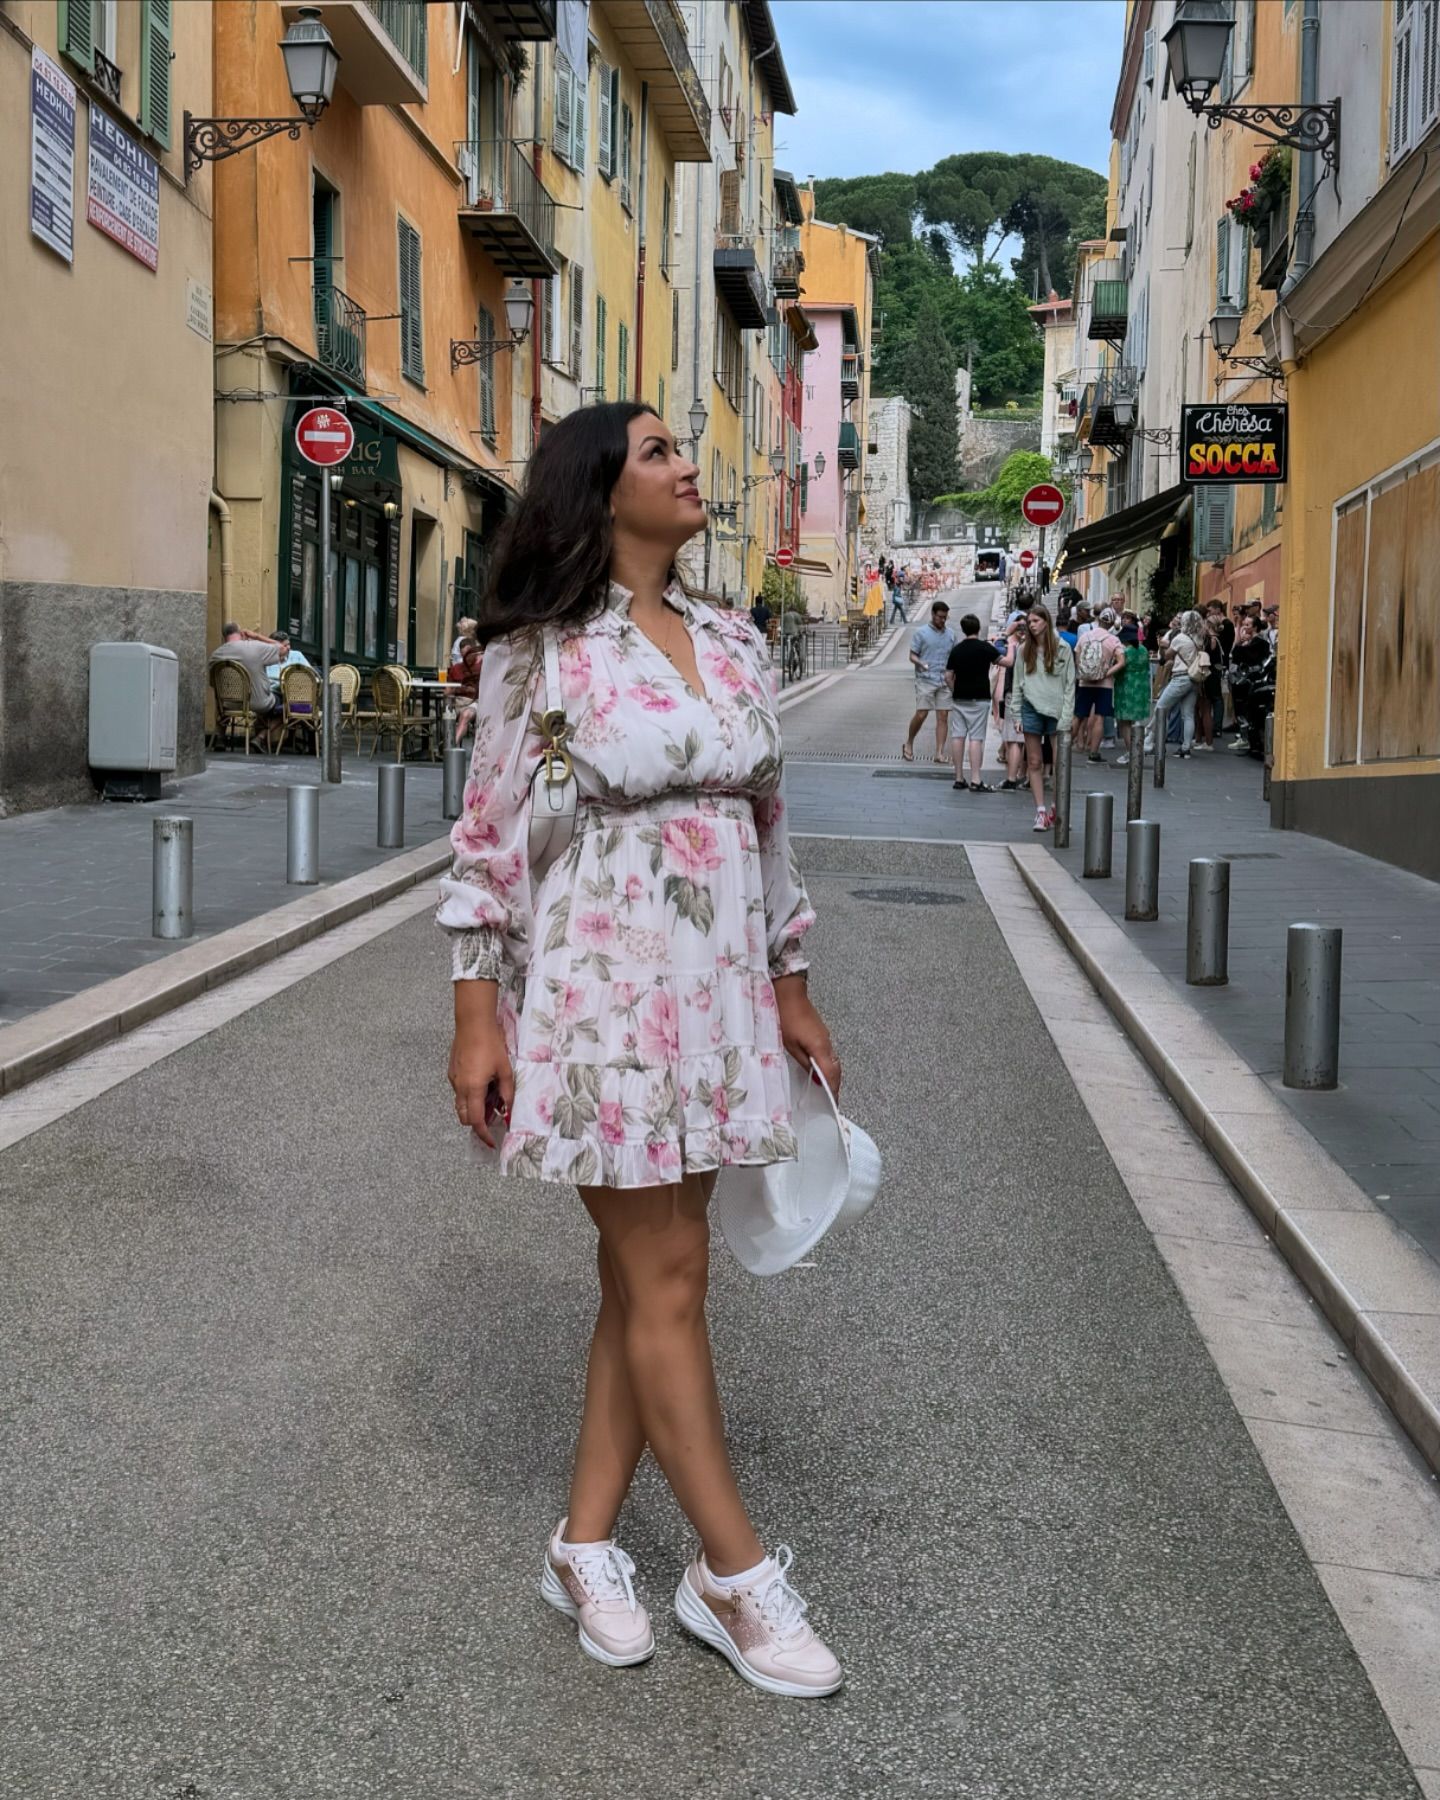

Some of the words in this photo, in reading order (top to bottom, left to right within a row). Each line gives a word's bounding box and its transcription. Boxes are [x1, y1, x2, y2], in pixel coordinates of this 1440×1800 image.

[36, 78, 73, 127] HEDHILI
[91, 107, 158, 181] HEDHILI
[90, 152, 128, 199] RAVALEMENT
[129, 187, 136, 207] DE
[90, 176, 115, 211] PEINTURE
[352, 466, 376, 476] BAR
[1189, 443, 1280, 475] SOCCA
